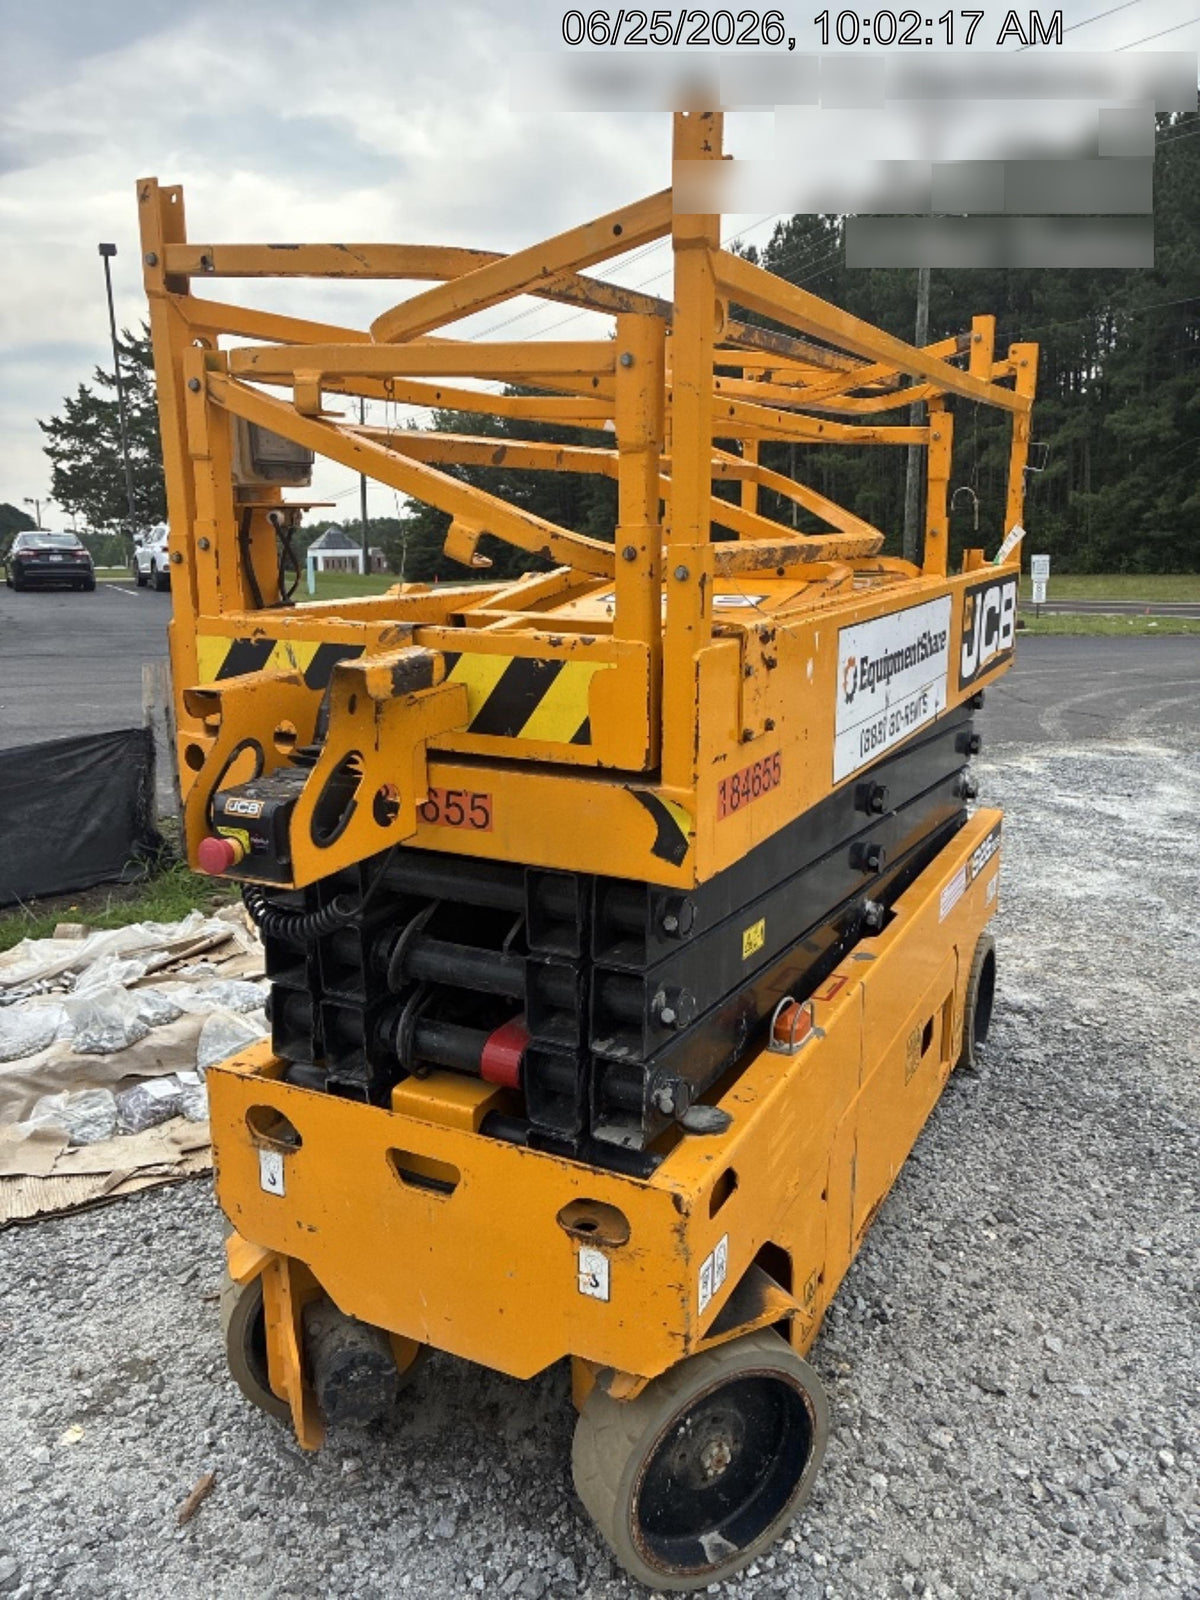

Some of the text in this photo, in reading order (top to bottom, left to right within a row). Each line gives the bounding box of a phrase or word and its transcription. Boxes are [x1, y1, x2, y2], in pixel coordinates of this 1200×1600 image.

[961, 581, 1016, 678] JCB
[858, 630, 947, 693] EquipmentShare
[228, 801, 260, 815] JCB
[720, 752, 781, 816] 184655
